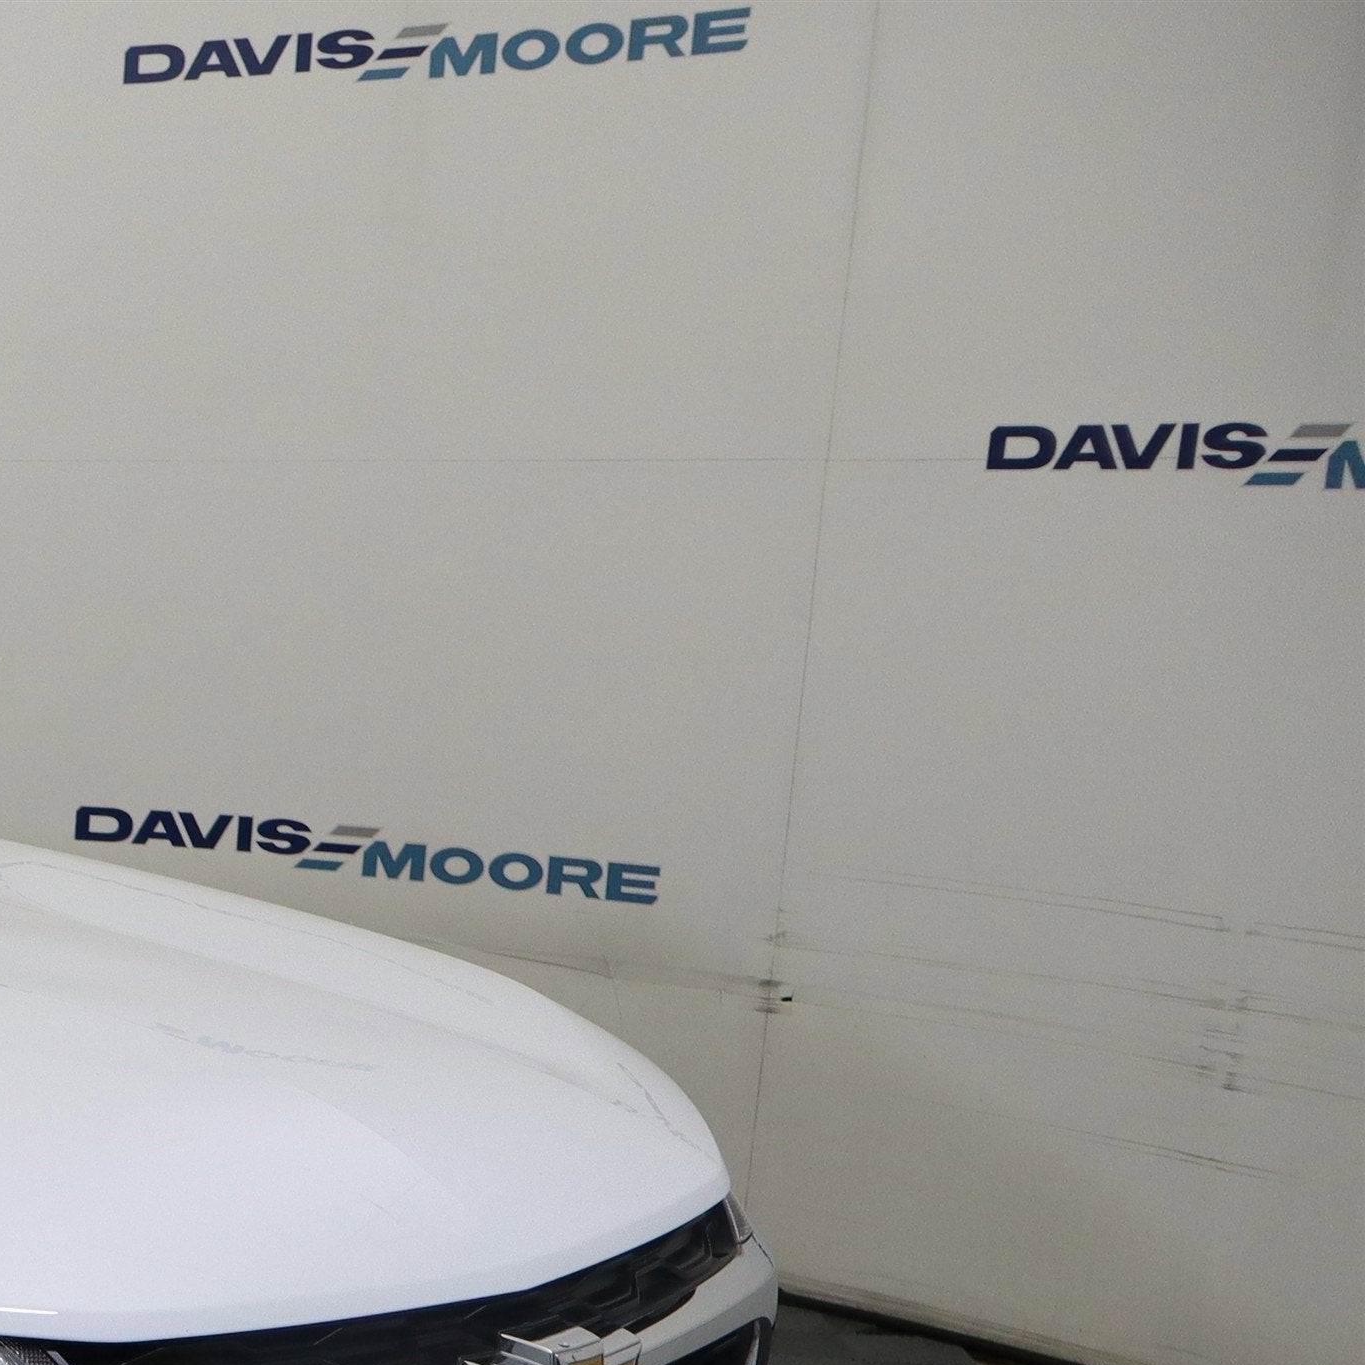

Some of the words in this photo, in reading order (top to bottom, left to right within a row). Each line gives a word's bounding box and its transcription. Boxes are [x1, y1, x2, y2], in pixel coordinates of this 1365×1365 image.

[122, 29, 376, 85] DAVIS
[429, 7, 752, 79] MOORE
[986, 422, 1268, 471] DAVIS
[74, 806, 312, 855] DAVIS
[362, 841, 661, 905] MOORE
